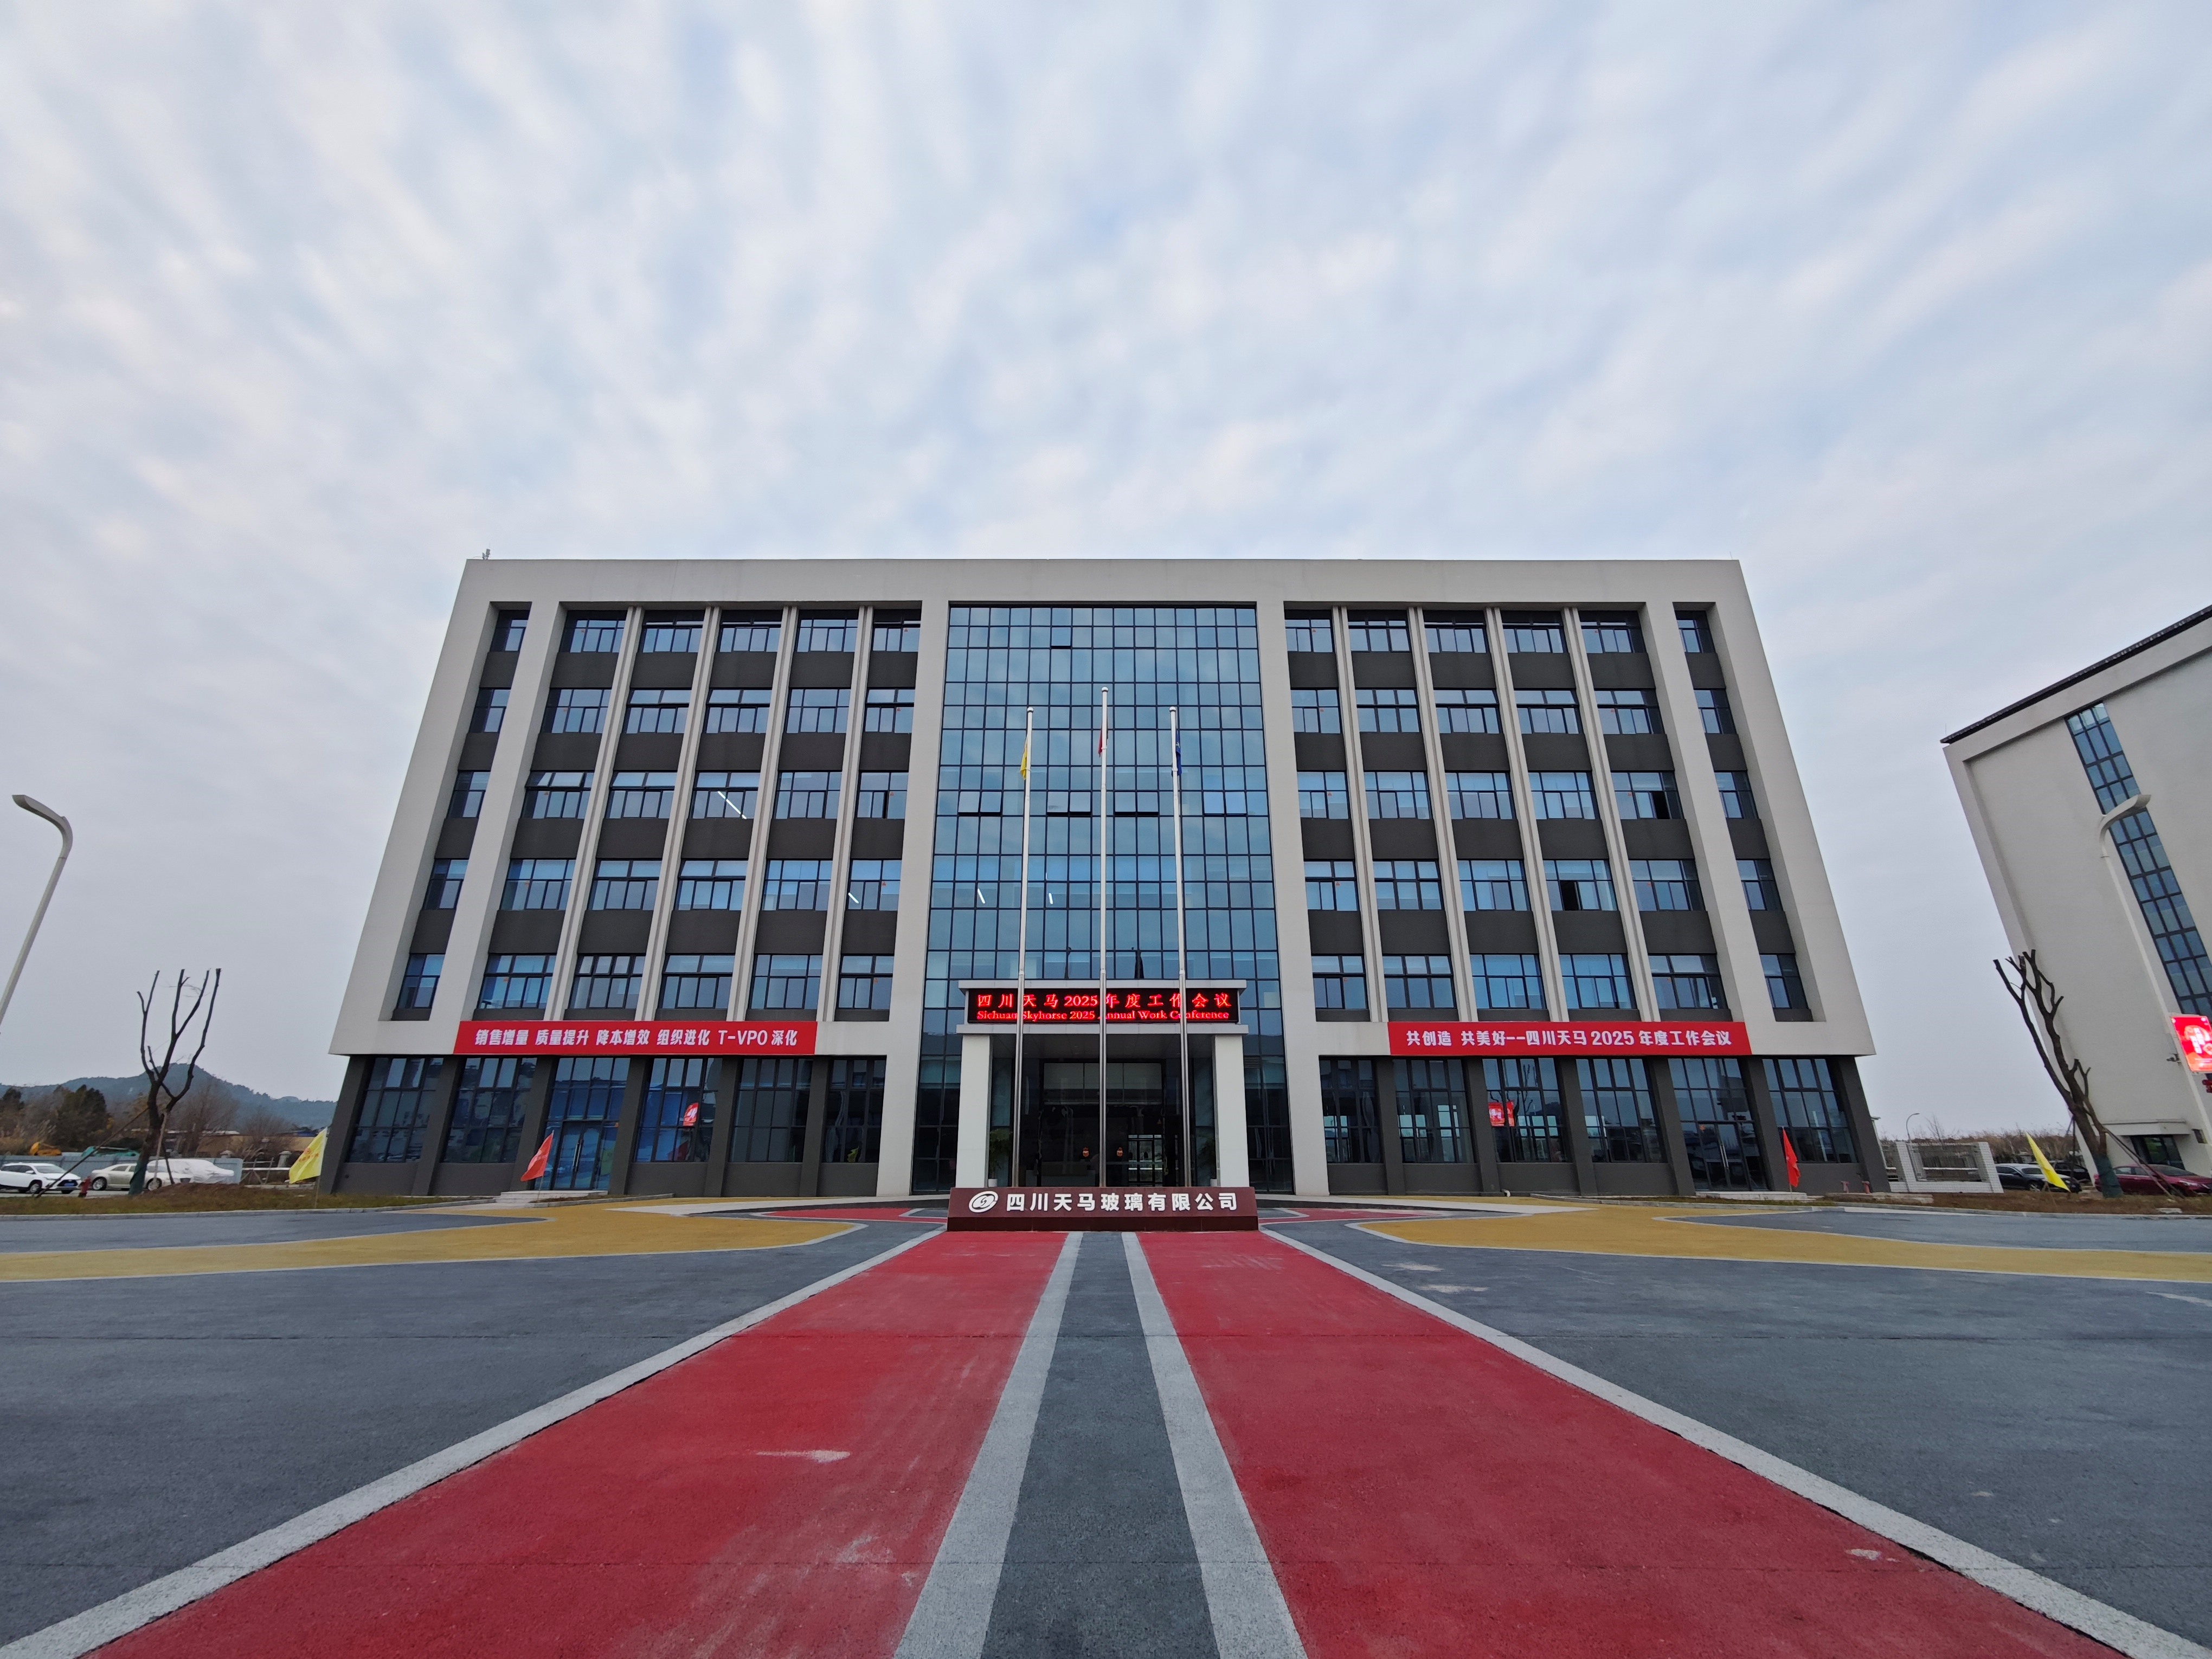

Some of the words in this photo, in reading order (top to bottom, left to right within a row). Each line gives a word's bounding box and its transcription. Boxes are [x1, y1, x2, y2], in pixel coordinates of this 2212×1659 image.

[976, 1010, 1018, 1020] Sichuan
[1069, 1010, 1096, 1020] 2025
[1137, 1009, 1168, 1020] Work
[475, 1029, 529, 1046] 销售增量
[535, 1029, 589, 1046] 质量提升
[596, 1029, 651, 1046] 降本增效
[657, 1029, 711, 1046] 组织进化
[718, 1030, 768, 1045] T-VPO
[771, 1030, 798, 1046] 深化
[1406, 1030, 1452, 1046] 共创造
[1591, 1031, 1635, 1045] 2025
[1638, 1030, 1732, 1046] 年度工作会议
[1006, 1192, 1237, 1212] 四川天马玻璃有限公司
